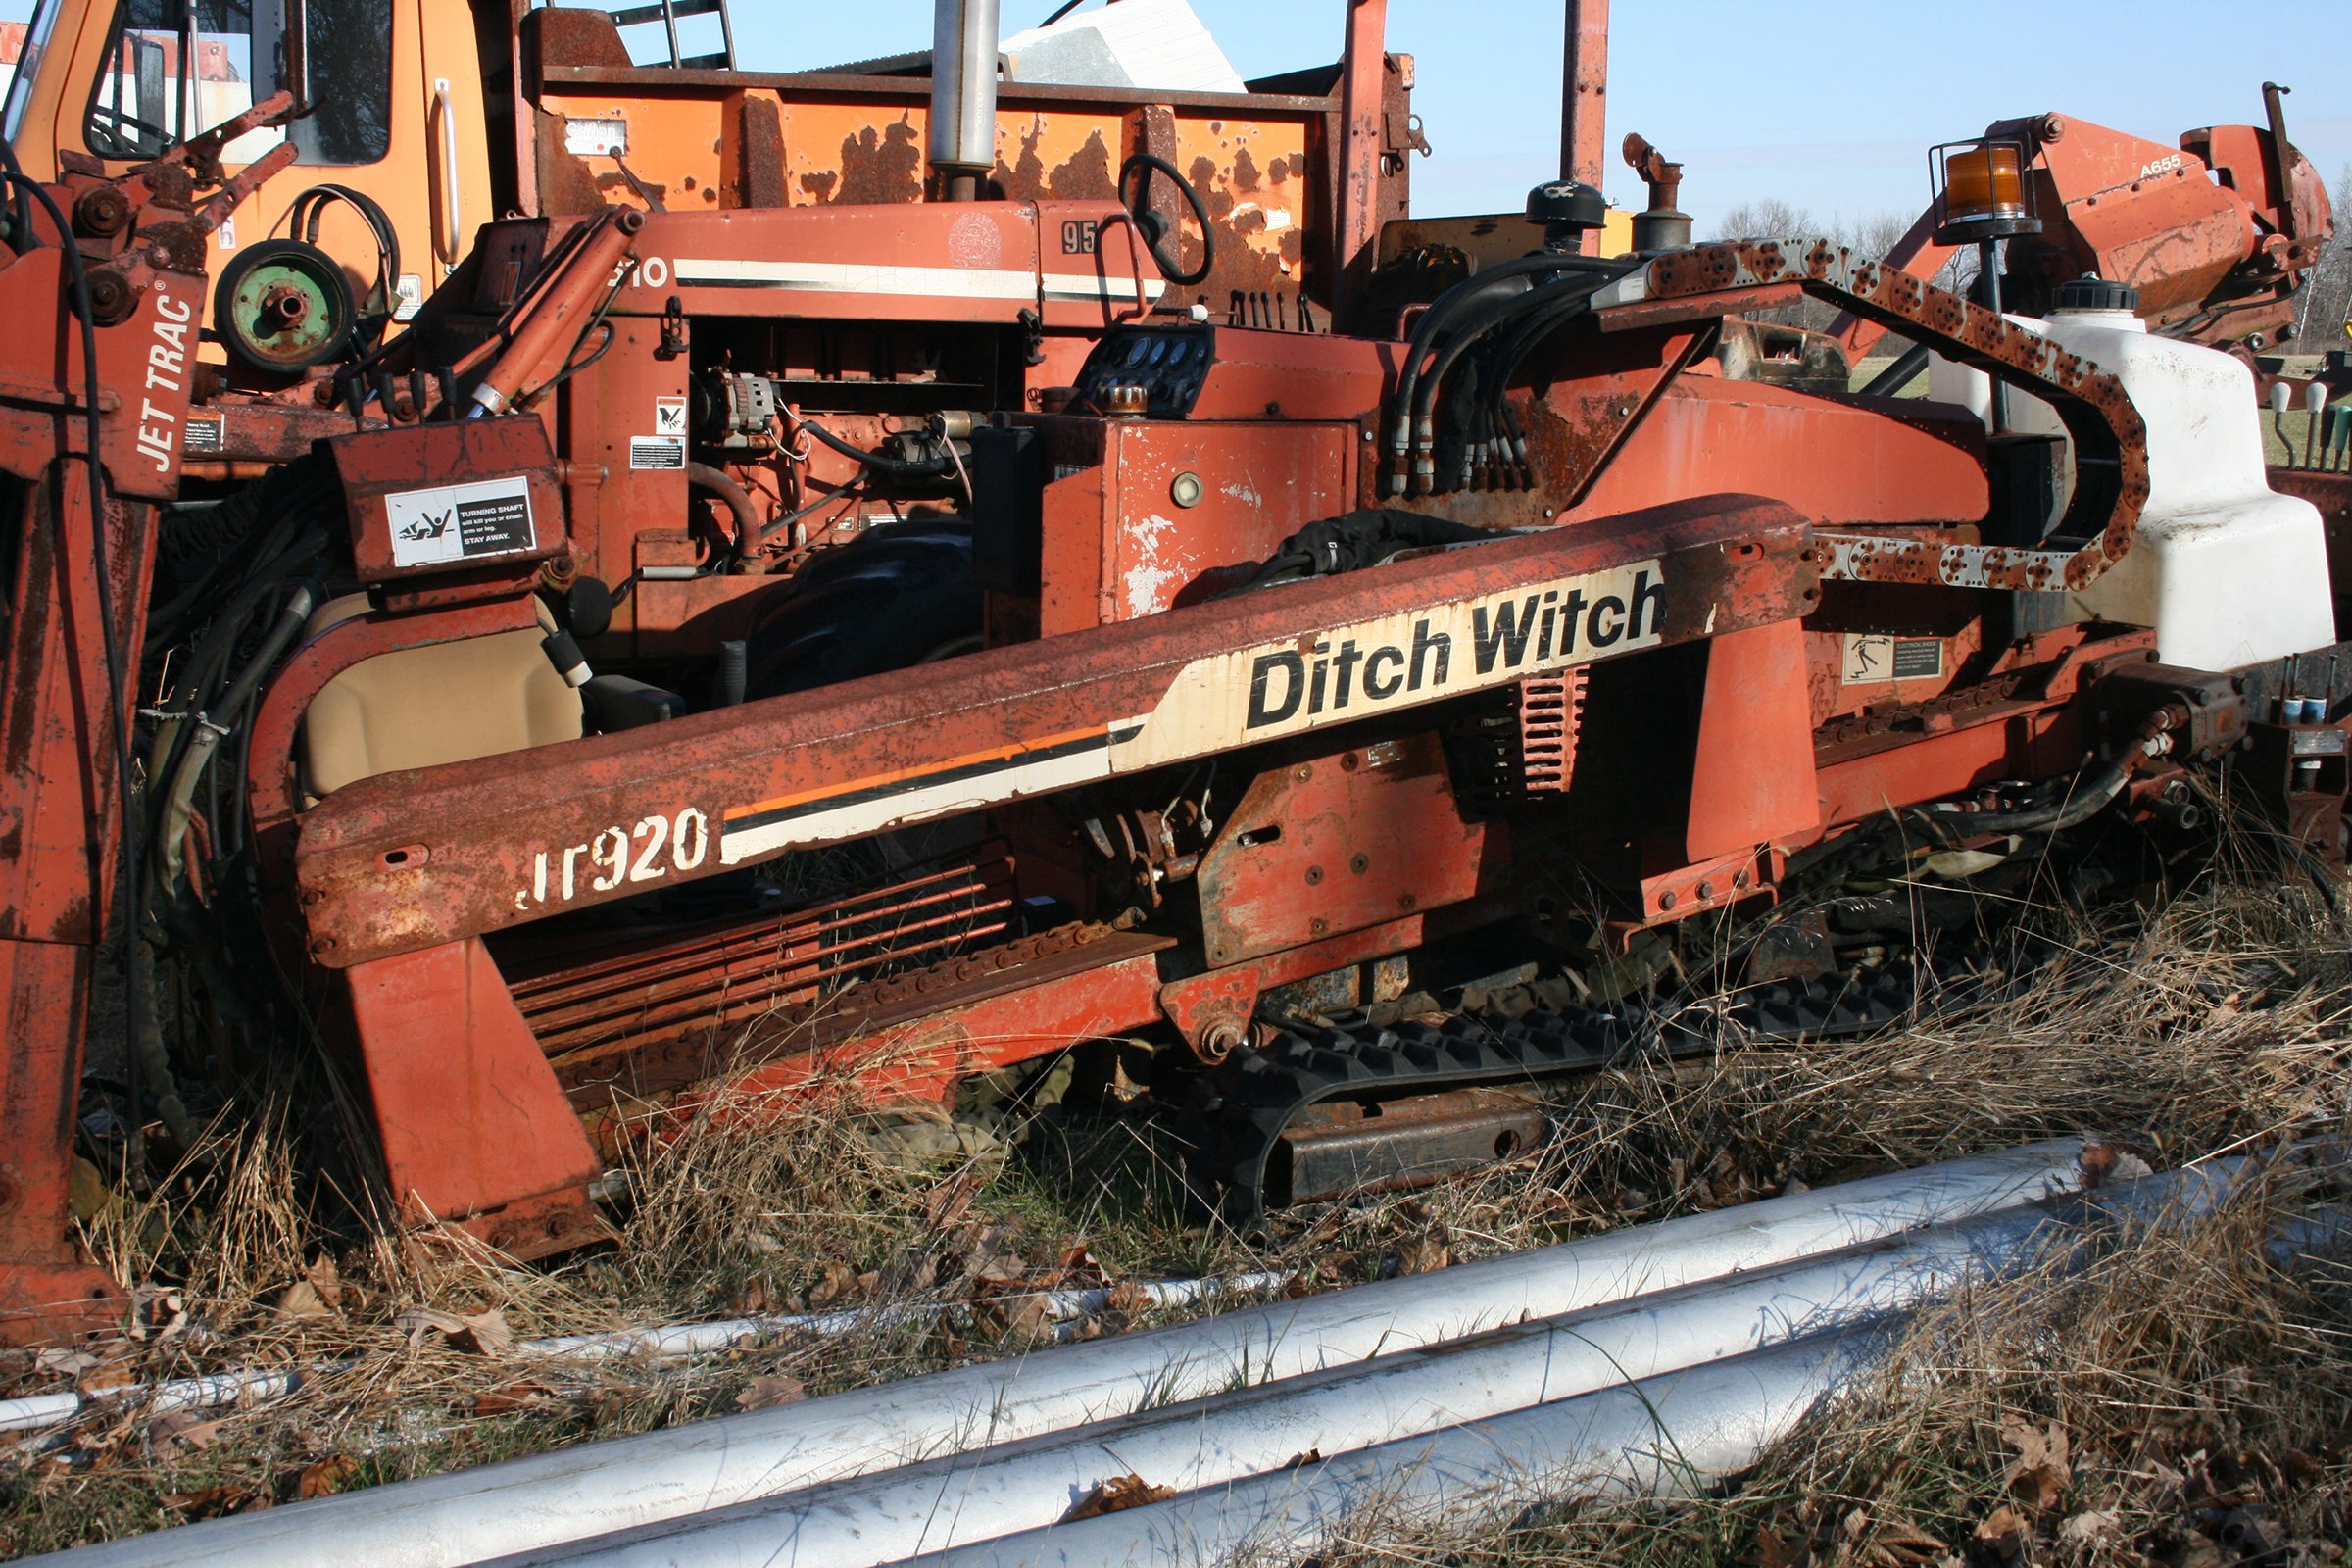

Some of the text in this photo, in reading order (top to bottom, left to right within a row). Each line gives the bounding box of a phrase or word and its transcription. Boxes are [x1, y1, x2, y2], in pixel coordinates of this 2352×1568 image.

[2140, 154, 2181, 178] A655
[1063, 220, 1096, 254] 95
[136, 397, 175, 472] JET
[460, 504, 524, 517] TURNING SHAFT
[465, 532, 510, 545] STAY AWAY.
[1246, 571, 1667, 730] Ditch Witch
